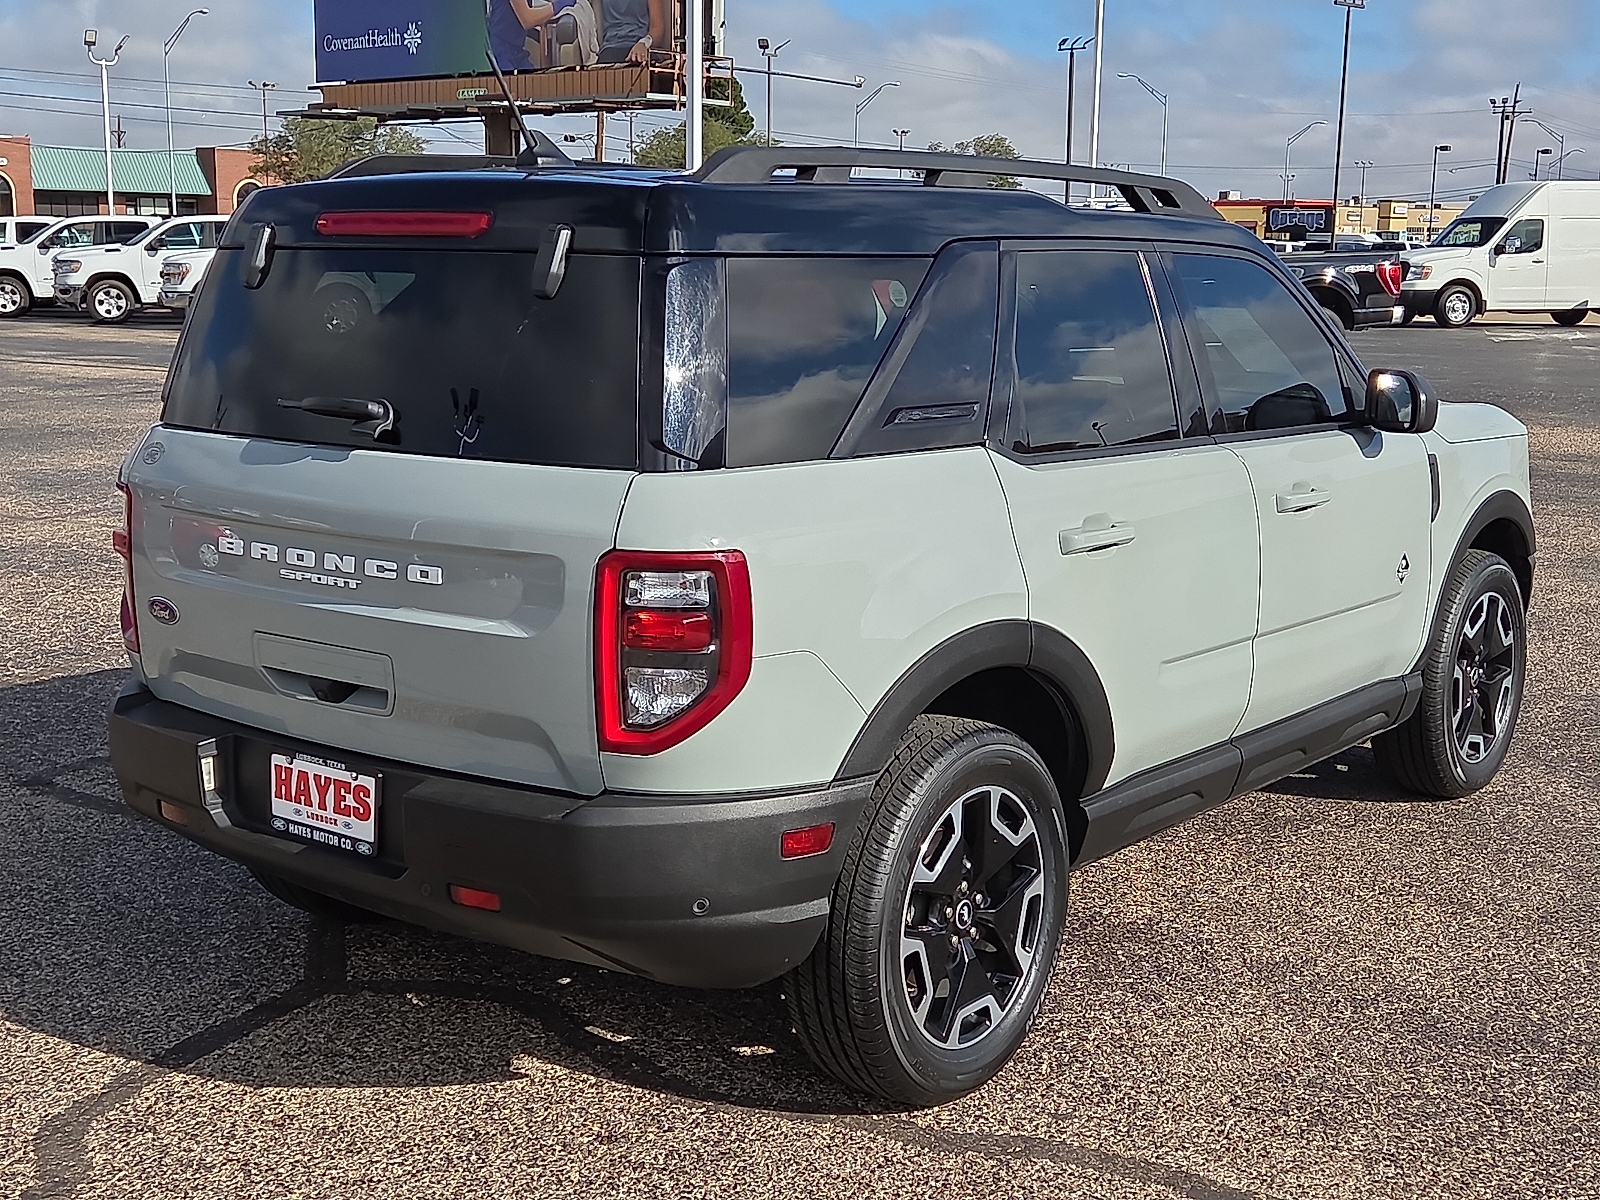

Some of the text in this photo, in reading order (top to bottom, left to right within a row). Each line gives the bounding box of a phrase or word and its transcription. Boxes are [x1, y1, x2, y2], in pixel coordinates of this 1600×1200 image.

[323, 27, 402, 52] CovenantHealth
[1270, 208, 1326, 231] Garage
[217, 535, 444, 586] BRONCO
[279, 568, 362, 590] SPORT
[151, 601, 170, 620] Ford
[326, 758, 346, 770] TEXAS
[273, 763, 372, 822] HAYES
[305, 810, 339, 827] LUBBOCK
[288, 823, 312, 839] HAYES
[312, 830, 339, 846] MOTOR
[340, 838, 354, 851] CO.
